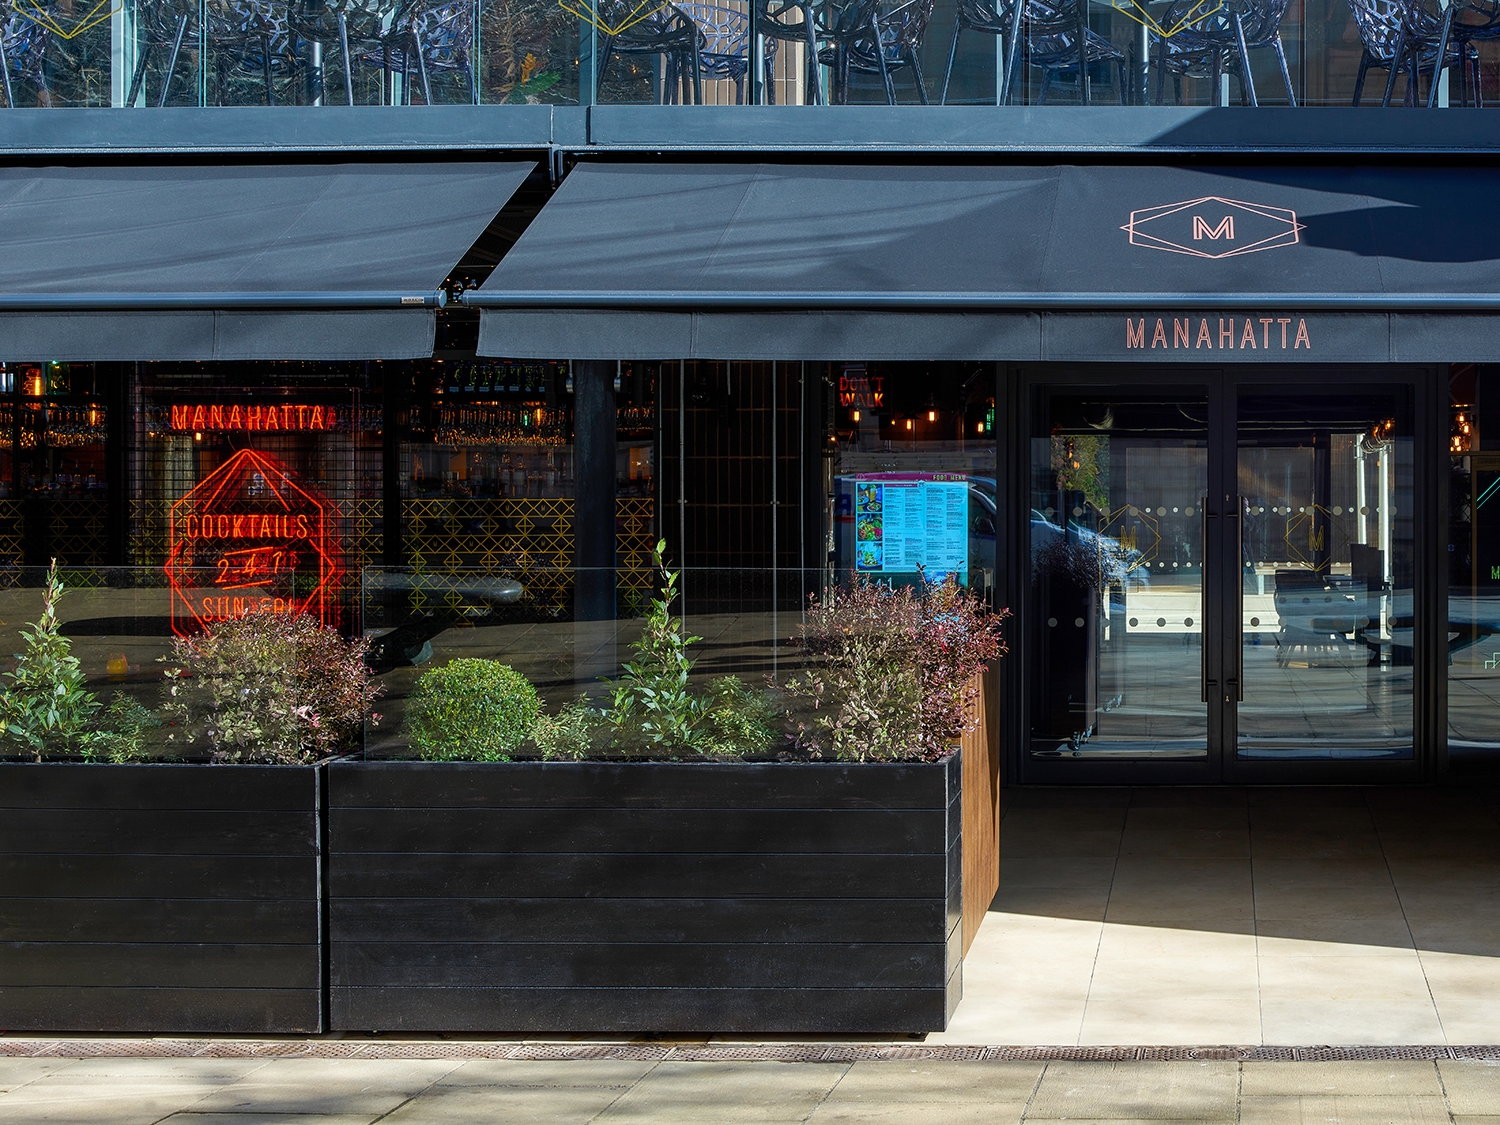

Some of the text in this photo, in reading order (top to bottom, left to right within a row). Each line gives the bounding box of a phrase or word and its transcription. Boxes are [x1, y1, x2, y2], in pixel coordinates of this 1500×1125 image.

[1193, 216, 1234, 240] M
[1126, 317, 1311, 349] MANAHATTA
[839, 376, 884, 392] DON'T
[172, 405, 325, 431] MANAHATTA
[187, 515, 309, 539] COCKTAILS
